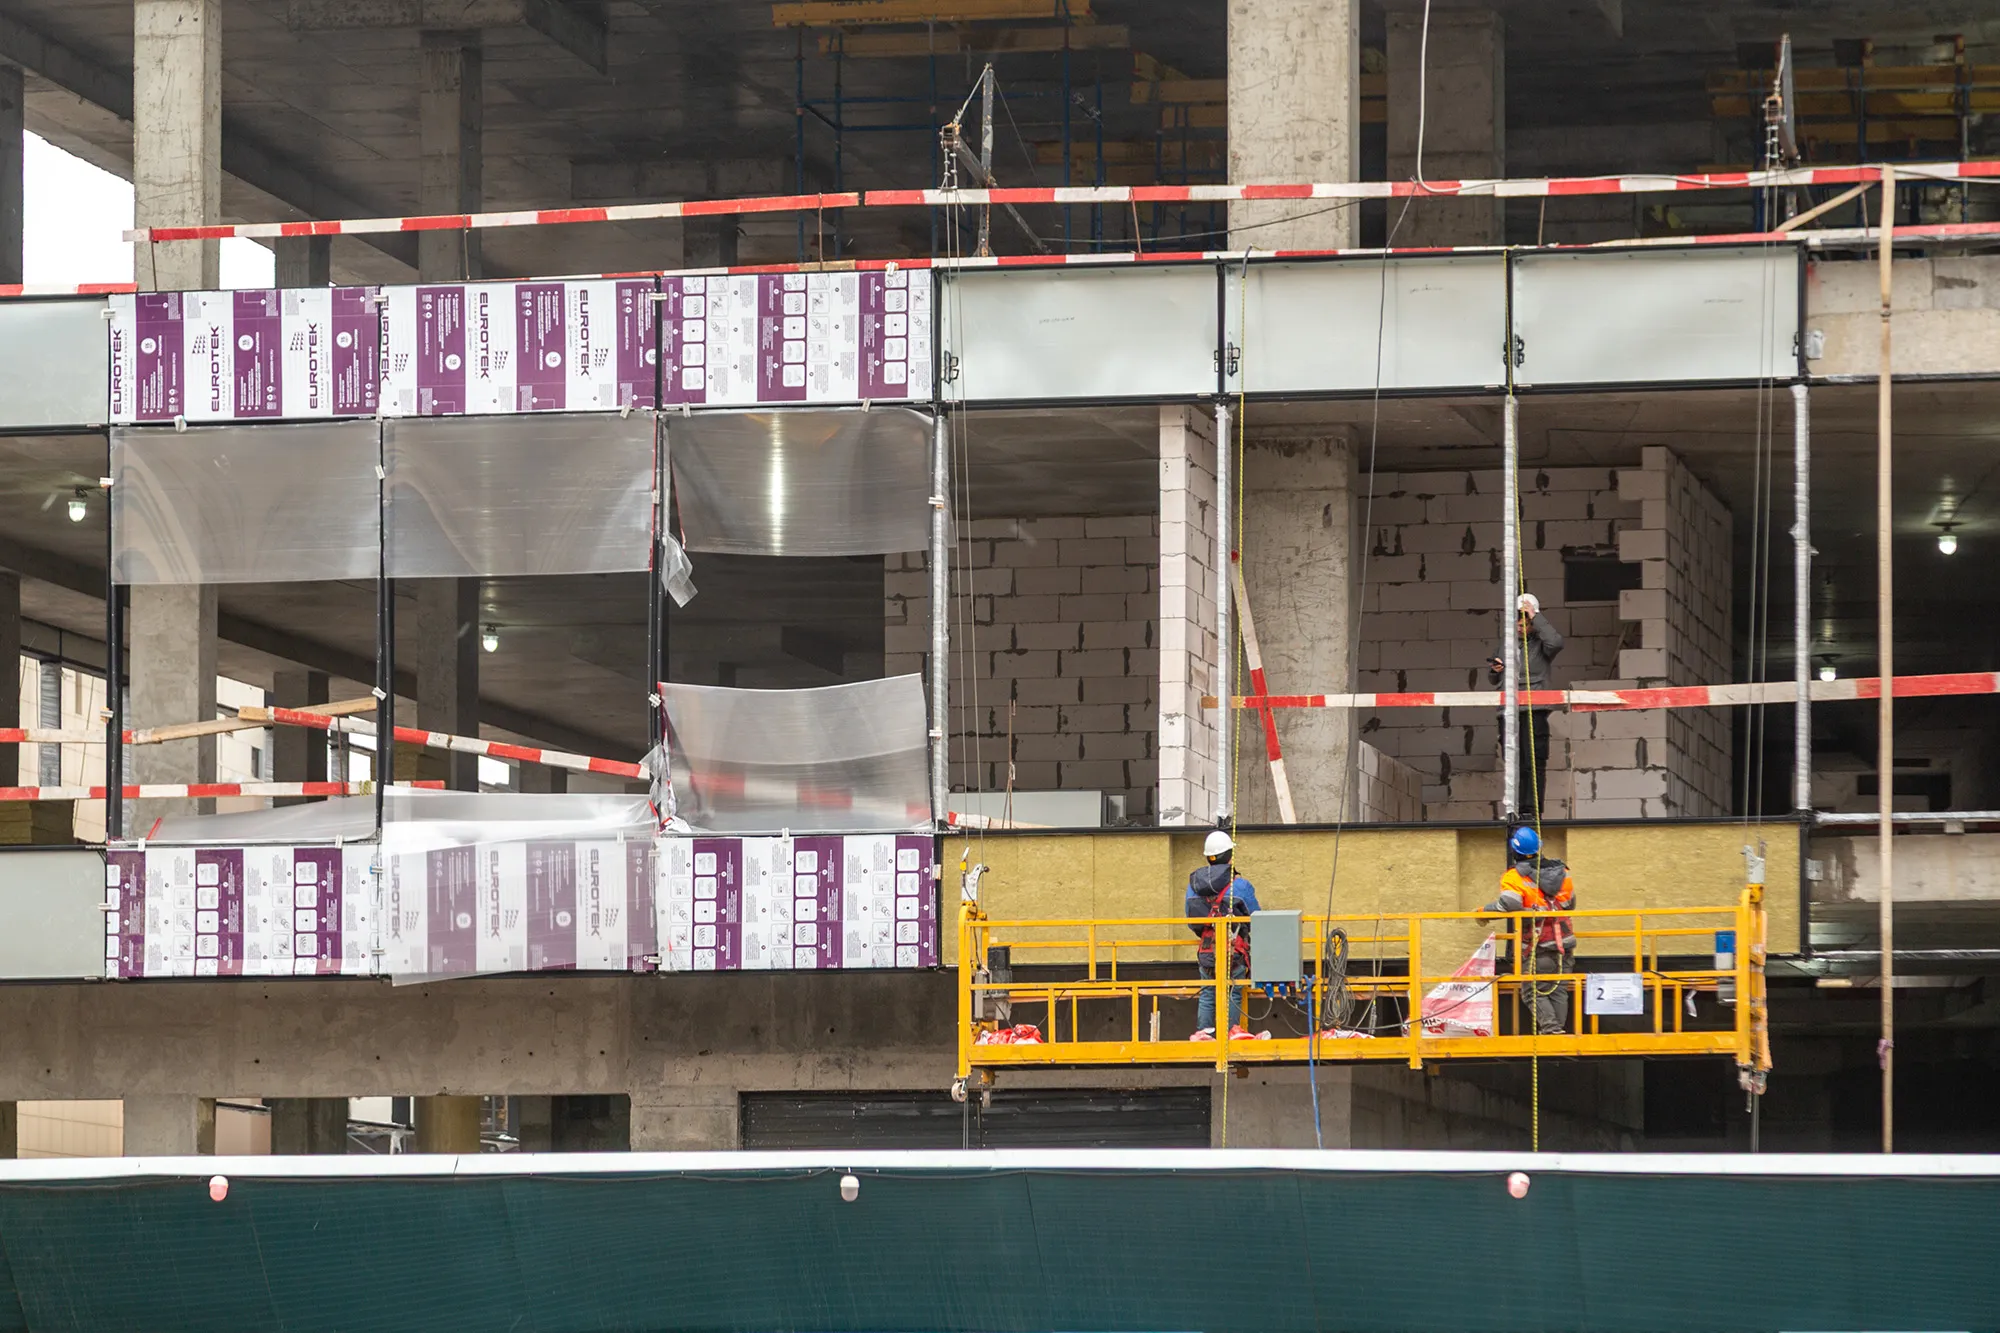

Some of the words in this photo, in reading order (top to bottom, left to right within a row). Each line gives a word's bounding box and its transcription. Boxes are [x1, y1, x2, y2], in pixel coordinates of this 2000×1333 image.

[113, 329, 122, 415] EUROTEK
[210, 326, 220, 412] EUROTEK
[308, 323, 318, 409] EUROTEK
[480, 292, 489, 379] EUROTEK
[580, 289, 590, 376] EUROTEK
[391, 854, 401, 940] EUROTEK
[490, 850, 500, 938] EUROTEK
[590, 848, 600, 937] EUROTEK
[1596, 987, 1605, 1001] 2
